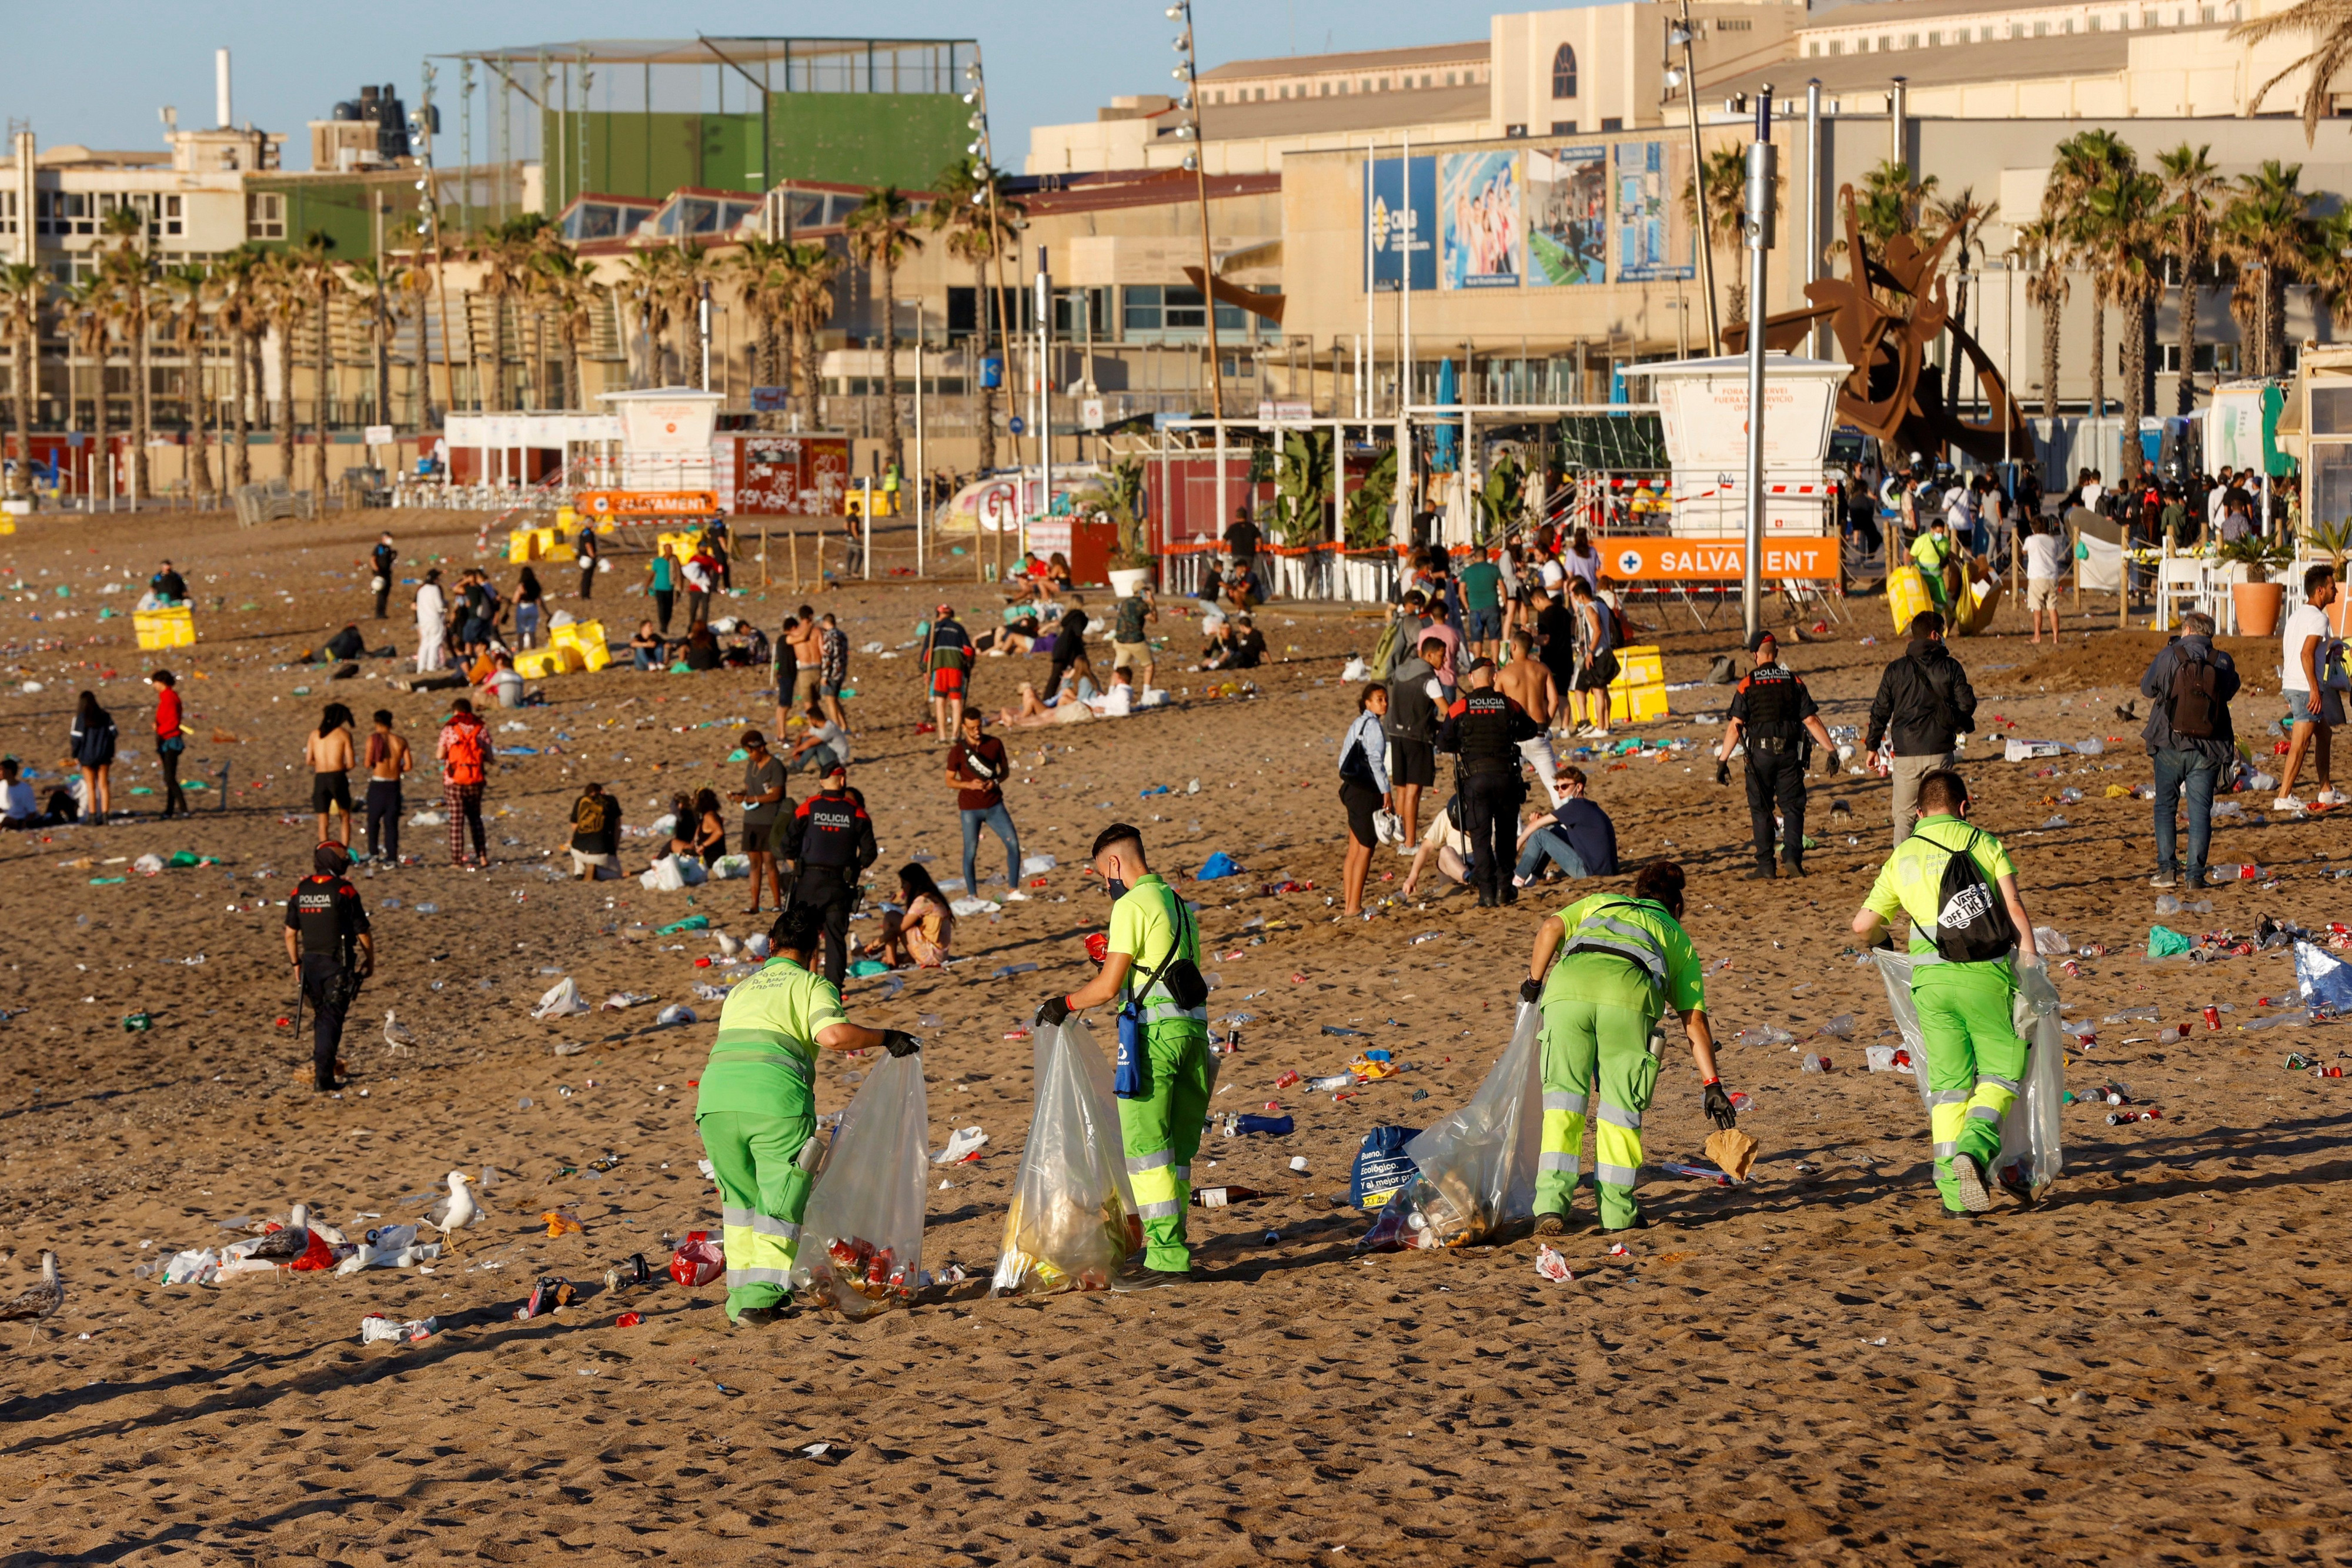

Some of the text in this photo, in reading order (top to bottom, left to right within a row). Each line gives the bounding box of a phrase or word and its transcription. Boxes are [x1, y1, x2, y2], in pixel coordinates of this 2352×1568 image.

[1718, 473, 1735, 486] 04
[1660, 551, 1819, 572] SALVAENT
[1754, 668, 1790, 677] POLICIA
[814, 813, 850, 824] POLICIA
[299, 894, 331, 904] POLICIA
[1952, 888, 1977, 907] VANS
[1962, 897, 1984, 916] THE
[1361, 1151, 1382, 1161] Bueno.
[1360, 1162, 1399, 1175] Ecológico.
[1366, 1180, 1374, 1189] al
[1375, 1176, 1399, 1186] mejor
